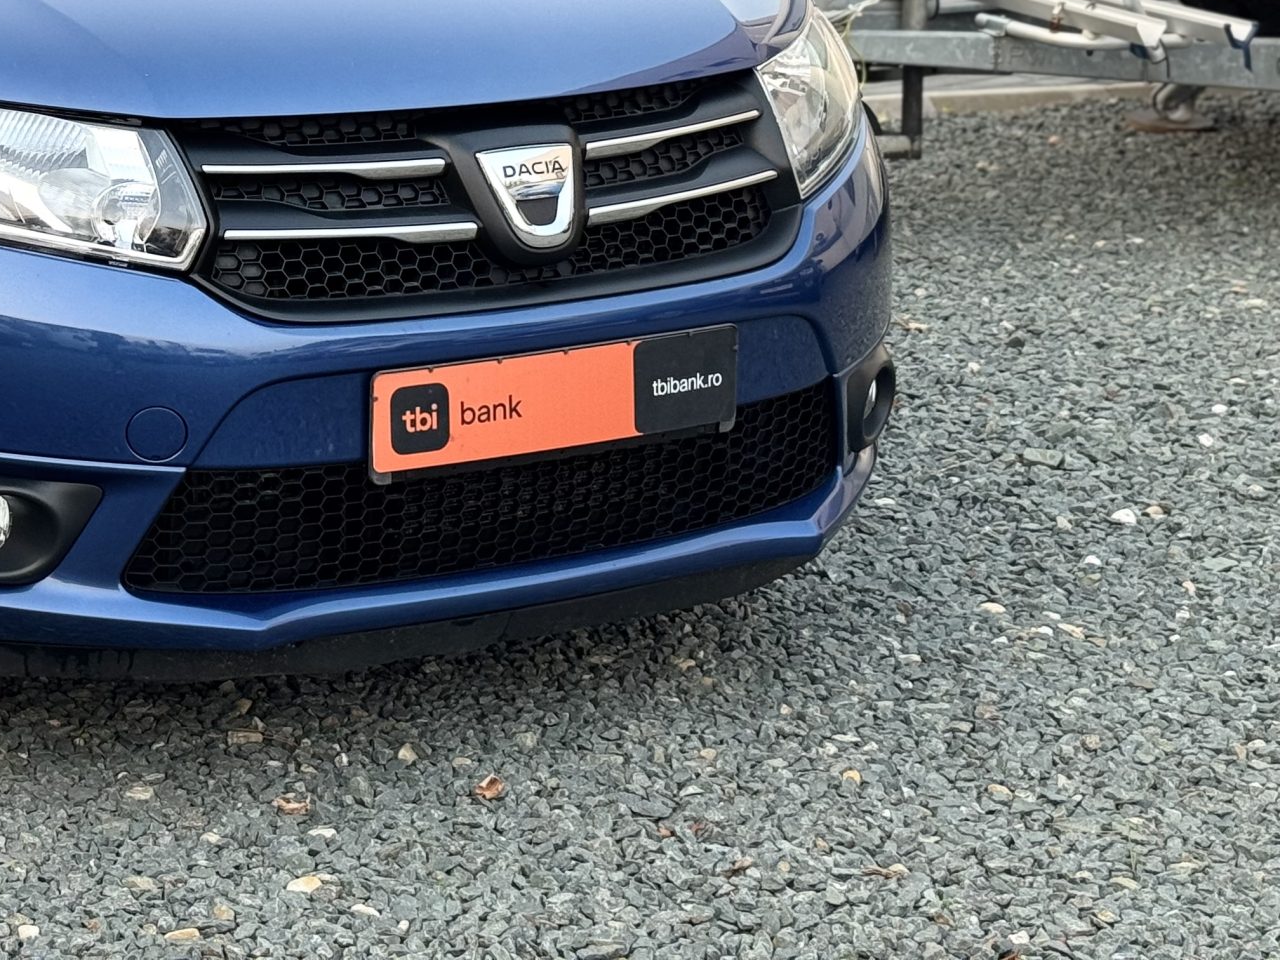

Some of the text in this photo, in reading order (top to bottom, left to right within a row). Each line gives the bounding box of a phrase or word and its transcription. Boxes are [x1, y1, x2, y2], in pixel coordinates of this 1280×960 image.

[501, 158, 565, 178] DACIA
[401, 371, 723, 433] tbi bank tbibank.ro
